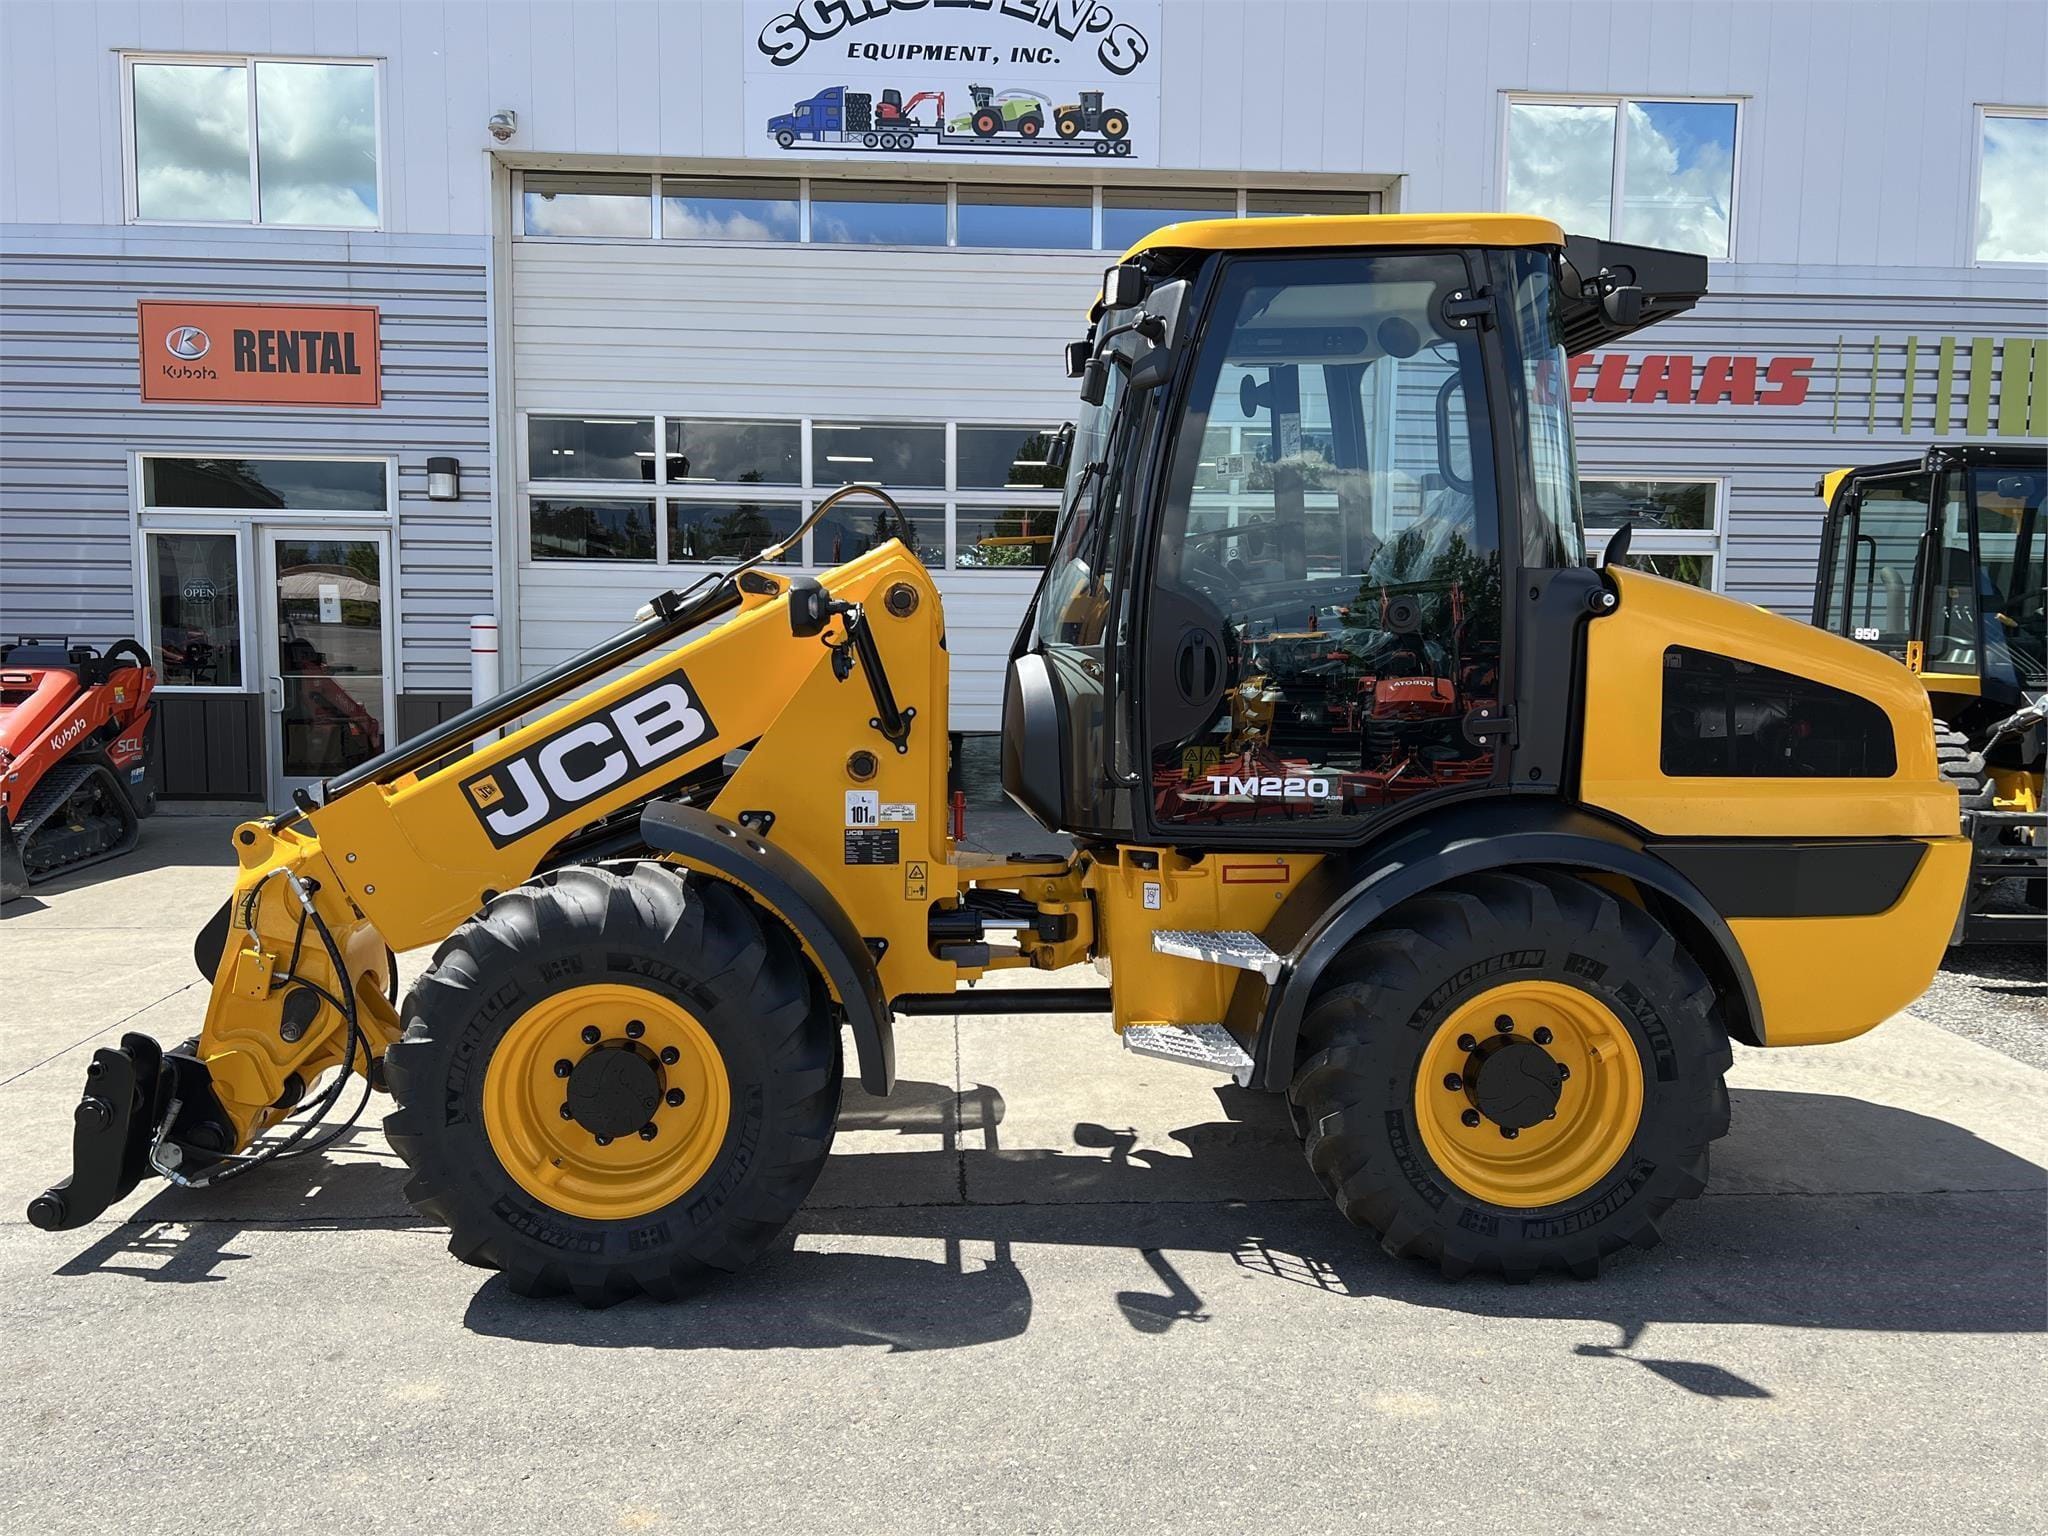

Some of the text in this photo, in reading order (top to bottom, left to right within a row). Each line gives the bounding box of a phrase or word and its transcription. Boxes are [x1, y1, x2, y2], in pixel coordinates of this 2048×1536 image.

[847, 43, 1061, 65] EQUIPMENT, INC.
[233, 329, 361, 375] RENTAL
[162, 365, 218, 380] Kubota
[1566, 353, 1814, 405] CLAAS
[184, 588, 215, 598] OPEN
[1854, 627, 1880, 641] 950
[51, 717, 87, 750] Kubota
[117, 738, 142, 753] SCL
[486, 683, 706, 836] JCB
[1207, 775, 1330, 798] TM220
[851, 806, 869, 824] 101
[1429, 950, 1546, 1008] MICHELIN
[1523, 1178, 1637, 1239] MICHELIN
